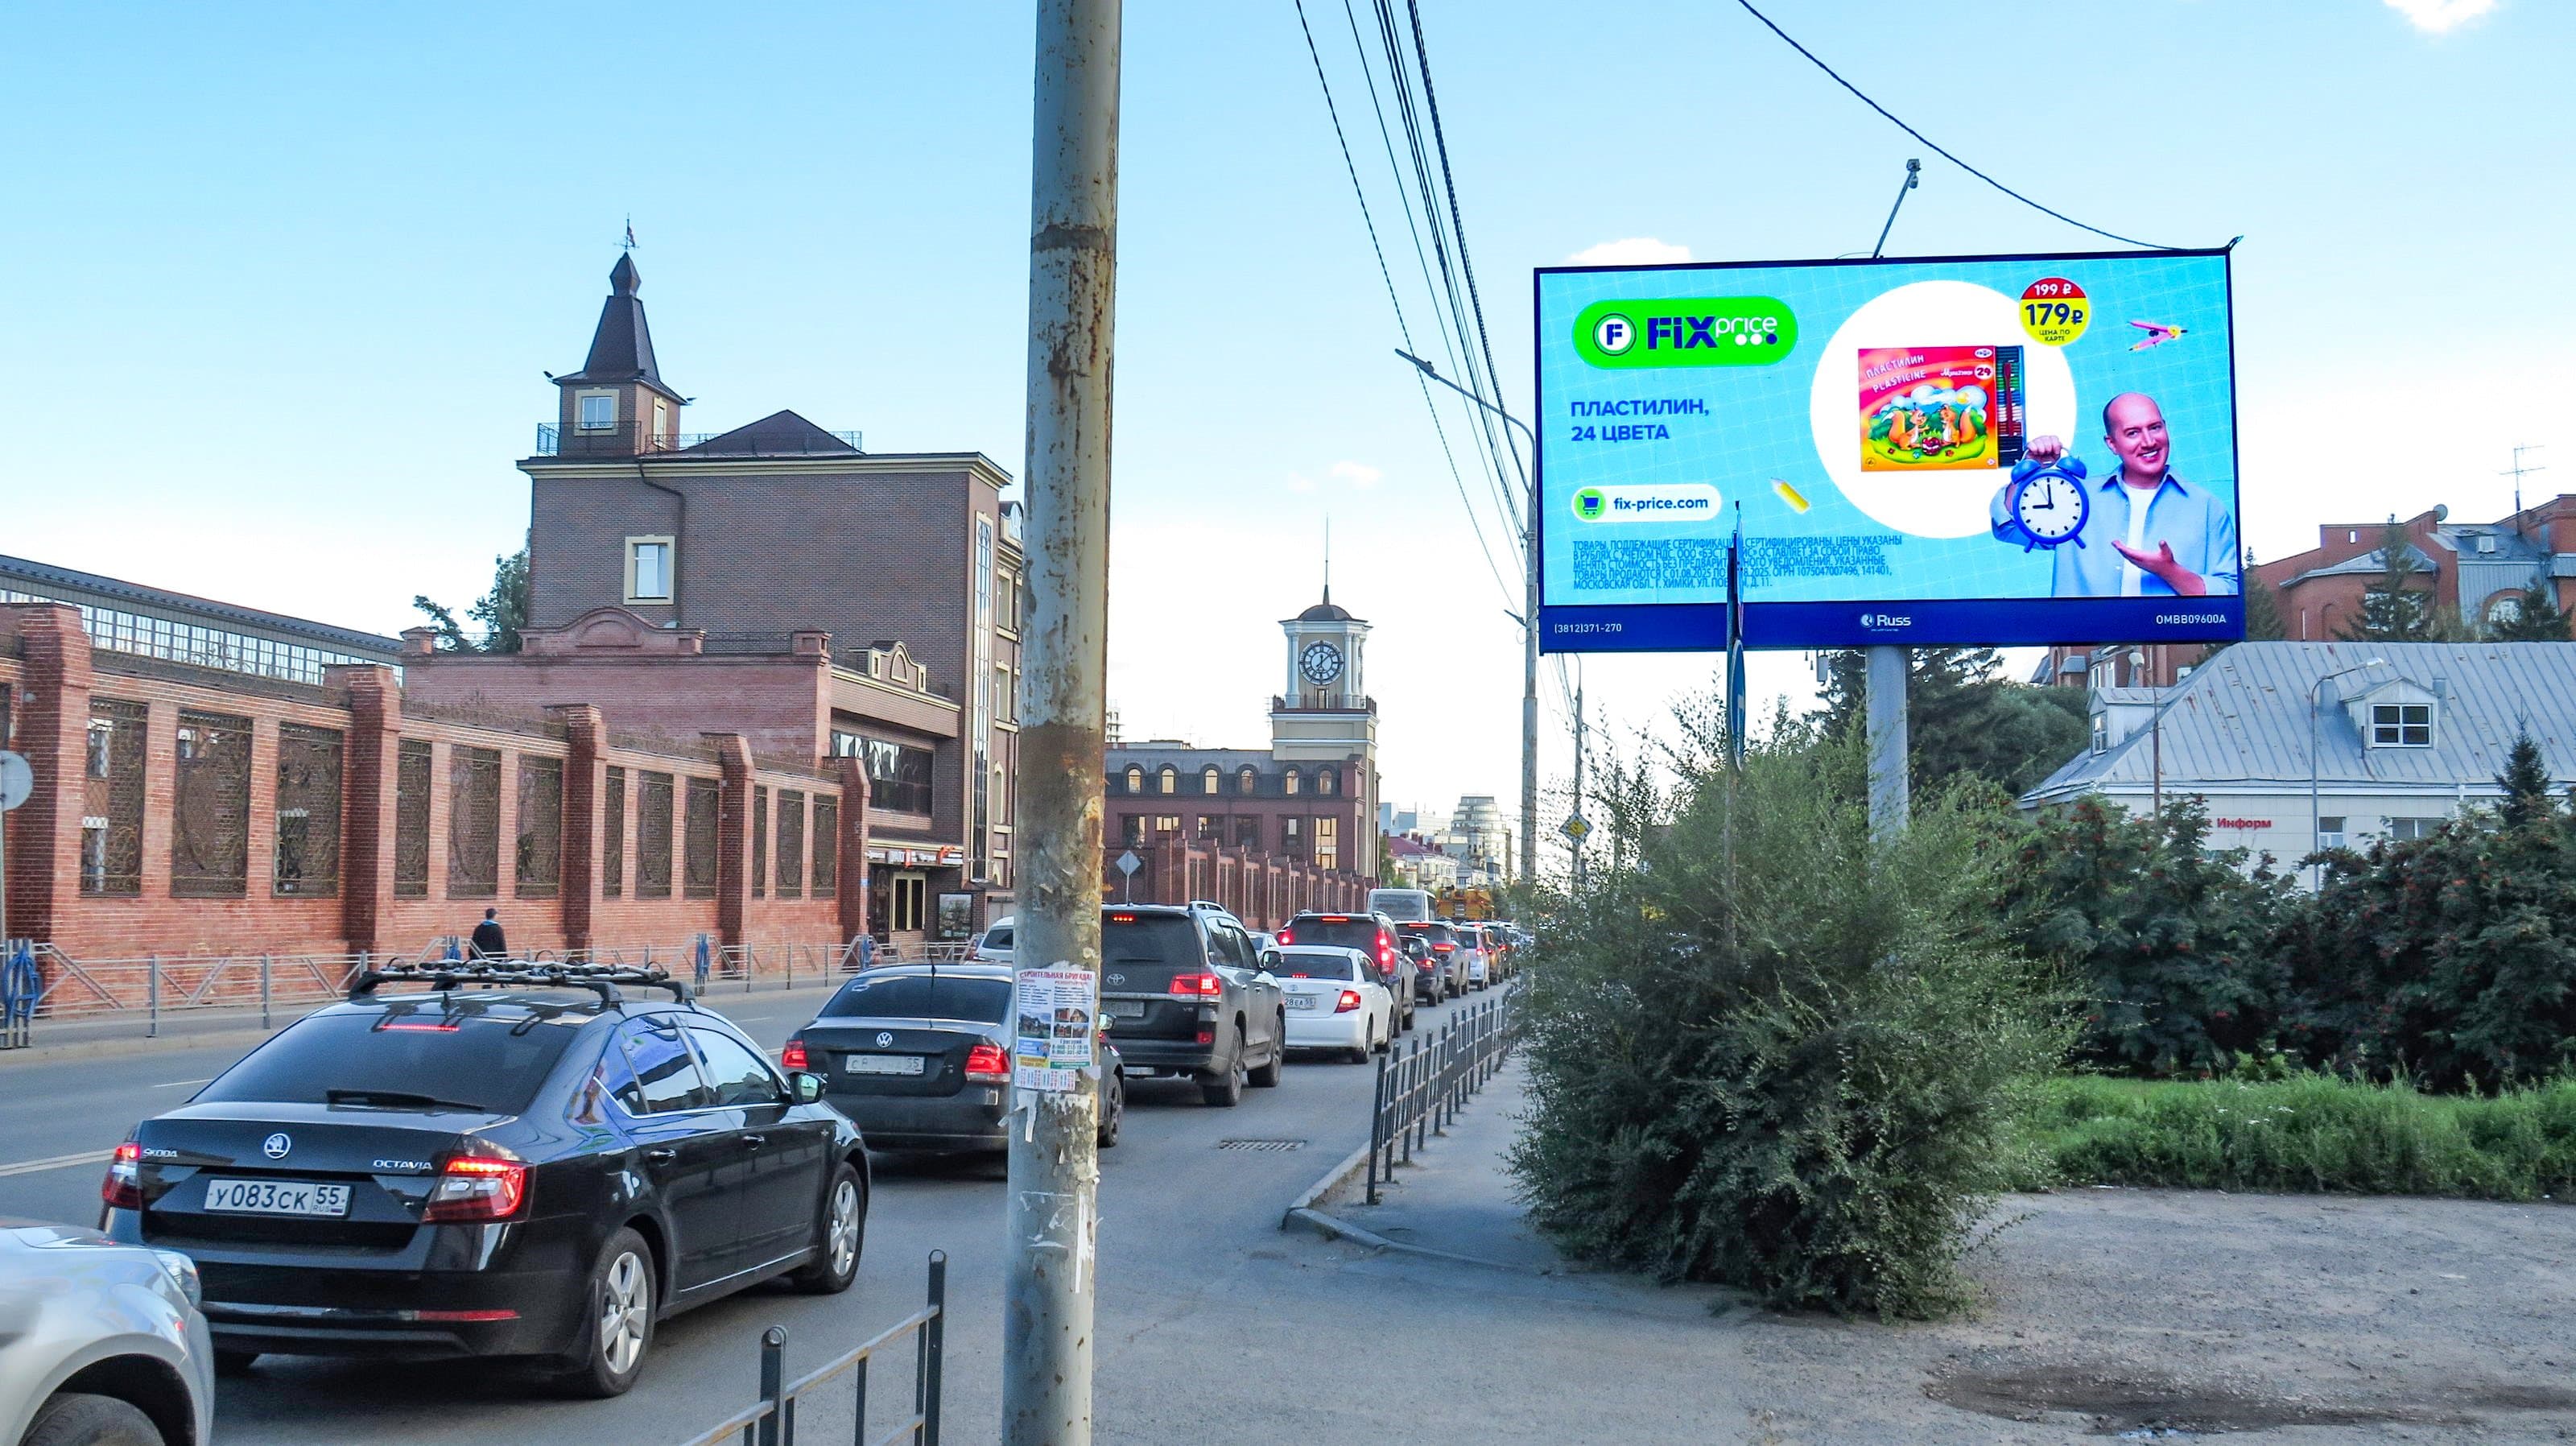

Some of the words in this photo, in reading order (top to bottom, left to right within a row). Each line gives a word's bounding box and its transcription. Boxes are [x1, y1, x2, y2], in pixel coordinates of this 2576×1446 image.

[2034, 283, 2058, 296] 199
[1715, 316, 1778, 338] price
[1865, 354, 1926, 380] ПЛАСТИЛИН
[1975, 367, 1992, 377] 24
[1872, 370, 1927, 394] PLASTICINE
[1571, 399, 1710, 417] ПЛАСТИЛИН,
[1571, 426, 1597, 441] 24
[1601, 424, 1670, 443] ЦВЕТА
[1613, 497, 1709, 512] fix-price.com
[1610, 539, 1671, 550] ПОДЛЕЖАЩИЕ
[1744, 536, 1835, 547] СЕРТИФИЦИРОВАНЫ.
[1835, 536, 1860, 547] ЦЕНЫ
[1861, 535, 1902, 546] УКАЗАНЫ
[1573, 550, 1579, 560] В
[1612, 550, 1619, 560] С
[1620, 549, 1653, 560] УЧЕТОМ
[1677, 548, 1696, 558] ООО
[1759, 547, 1806, 557] ОСТАВЛЯЕТ
[1808, 547, 1818, 557] ЗА
[1852, 545, 1880, 556] ПРАВО
[1574, 560, 1607, 570] МЕНЯТЬ
[1608, 560, 1661, 570] СТОИМОСТЬ
[1662, 559, 1678, 568] БЕЗ
[1835, 555, 1886, 566] УКАЗАННЫЕ
[1574, 570, 1608, 580] ТОВАРЫ
[1609, 569, 1662, 580] ПРОДАЮТСЯ
[1662, 569, 1668, 579] С
[1670, 568, 1711, 579] 01.08.2025
[1713, 568, 1727, 577] ПО
[1773, 567, 1795, 577] ОГРН
[1861, 565, 1893, 576] 141401,
[1574, 580, 1631, 589] МОСКОВСКАЯ
[1662, 578, 1696, 589] ХИМКИ,
[1876, 614, 1912, 626] Russ
[1554, 623, 1623, 634] (3812)371-270
[2216, 817, 2273, 830] Информ
[1019, 971, 1063, 980] СТРОИТЕЛЬНАЯ
[373, 1159, 433, 1171] OCTAVIA
[316, 1187, 341, 1205] 55
[312, 1204, 330, 1213] RUS
